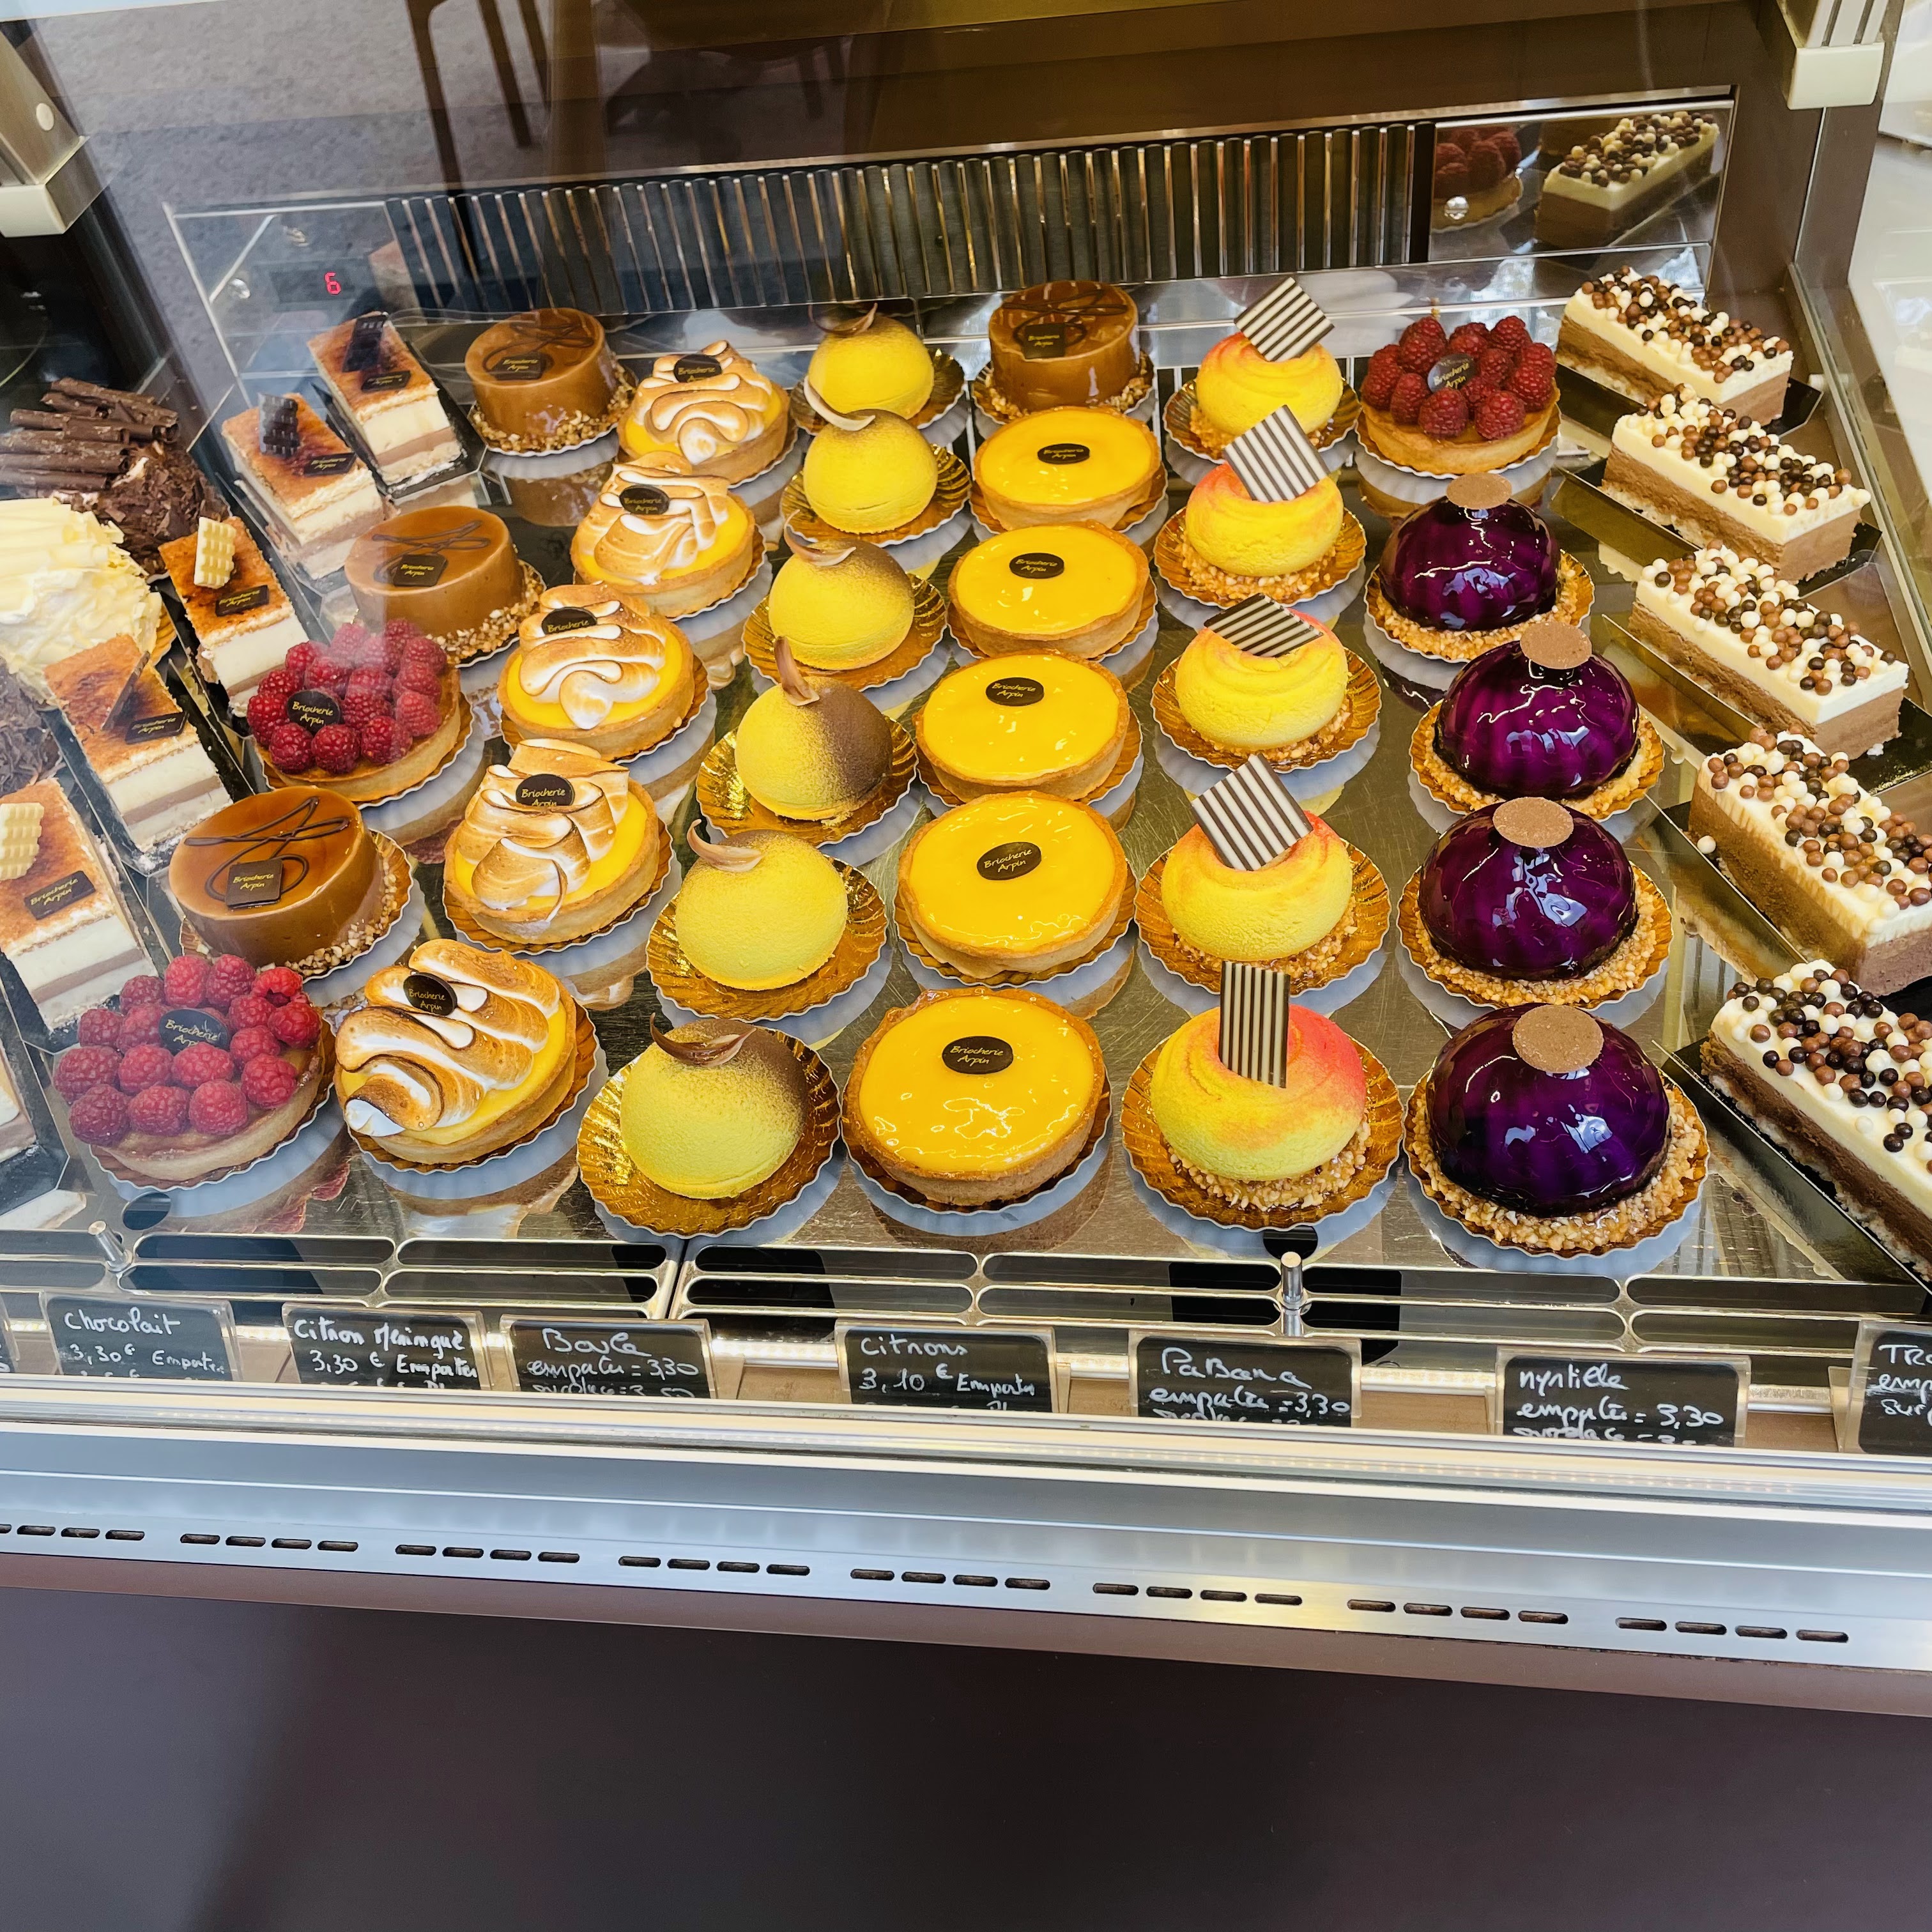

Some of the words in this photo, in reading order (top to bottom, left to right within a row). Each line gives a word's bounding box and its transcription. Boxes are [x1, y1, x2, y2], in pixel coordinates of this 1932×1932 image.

[325, 272, 341, 295] 6
[548, 620, 588, 632] Briocherie
[992, 683, 1036, 692] Briocherie
[997, 690, 1023, 698] Arpin
[293, 702, 334, 716] Briocherie
[300, 714, 324, 726] Arpin
[521, 788, 565, 798] Briocherie
[984, 848, 1032, 868] Briocherie
[998, 861, 1026, 872] Arpin
[233, 873, 274, 883] Briocherie
[30, 878, 78, 905] Briocherie
[240, 882, 264, 891] Arpin
[44, 888, 72, 905] Arpin
[409, 989, 446, 1000] Briocherie
[420, 1002, 442, 1013] Arpin
[173, 1034, 198, 1047] Arp
[950, 1046, 1004, 1055] Briocherie
[958, 1055, 989, 1066] Arpin
[293, 1316, 365, 1345] Citron
[861, 1333, 968, 1356] Citrons
